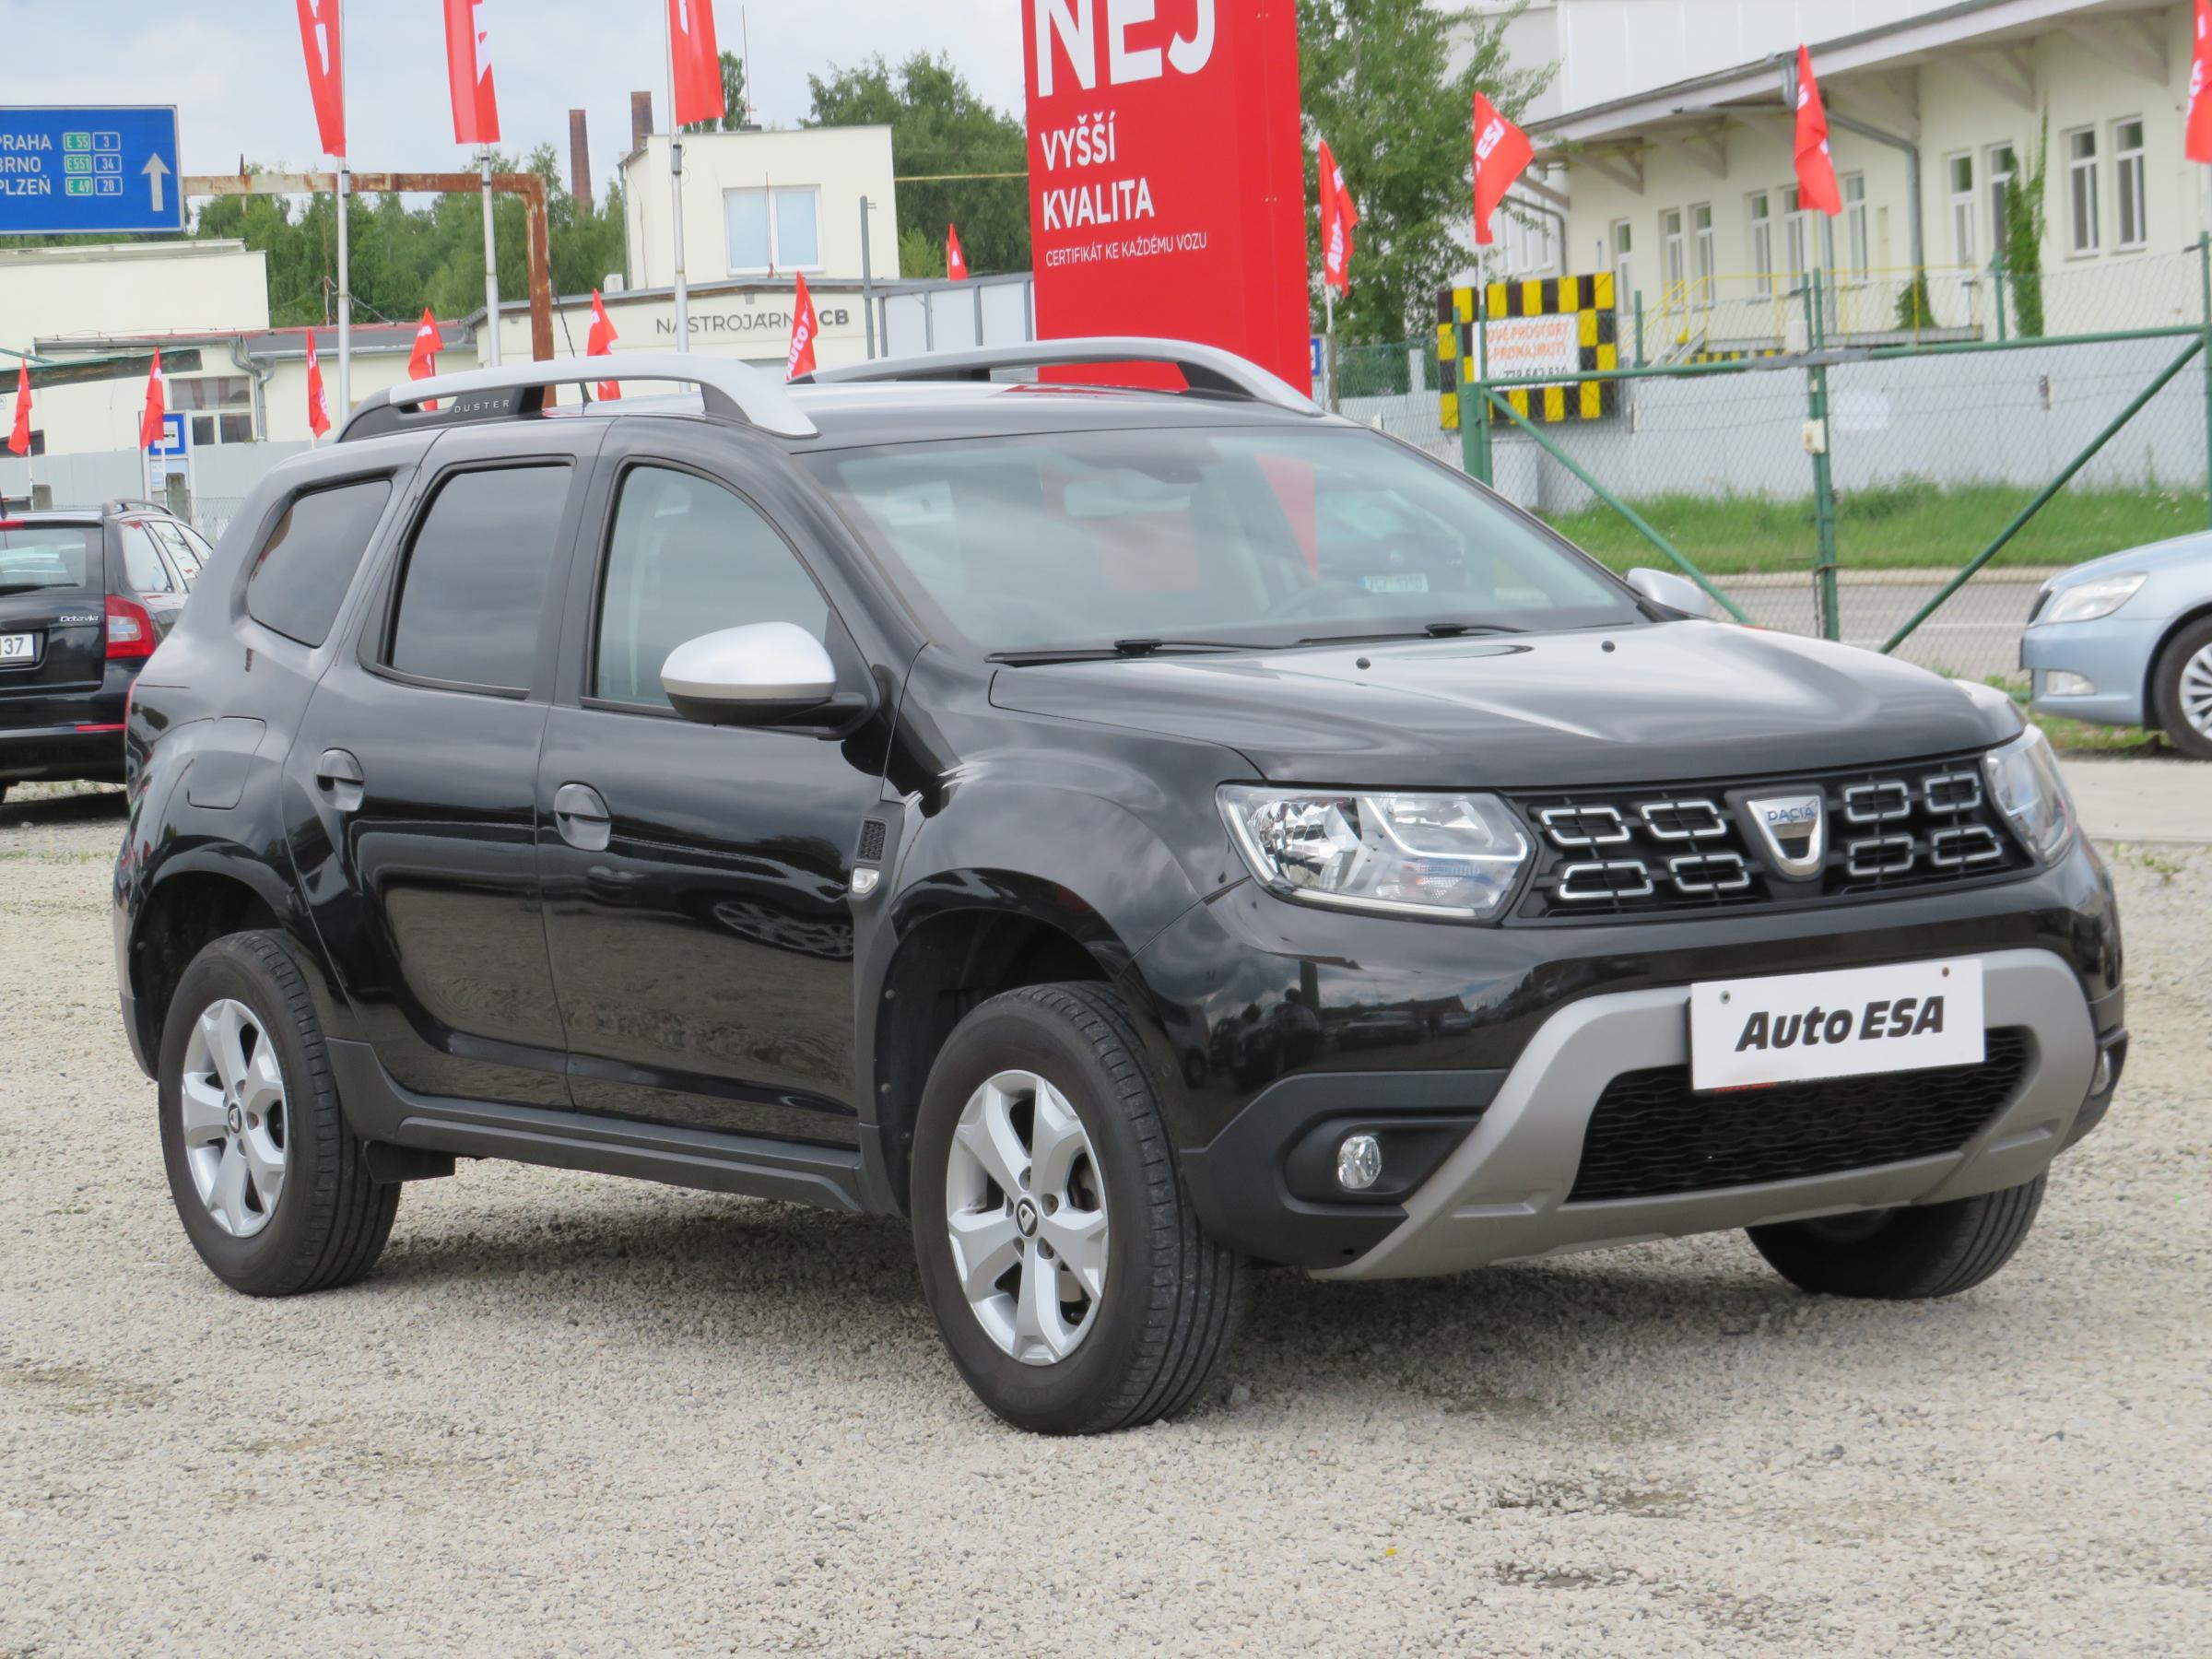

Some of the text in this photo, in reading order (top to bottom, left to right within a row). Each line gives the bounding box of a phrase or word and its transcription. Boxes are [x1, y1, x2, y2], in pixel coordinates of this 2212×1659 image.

[1034, 0, 1216, 98] NEJ
[103, 135, 110, 147] 3
[1040, 111, 1116, 171] VYŠŠÍ
[102, 158, 114, 170] 34
[102, 180, 114, 192] 20
[1042, 177, 1155, 230] KVALITA
[1045, 230, 1207, 266] CERTIFIKÁT KE KAŽDÉMU VOZU
[818, 309, 850, 326] CB
[454, 399, 510, 414] DUSTER
[1768, 806, 1815, 821] DACIA
[1735, 995, 1945, 1053] Auto ESA
